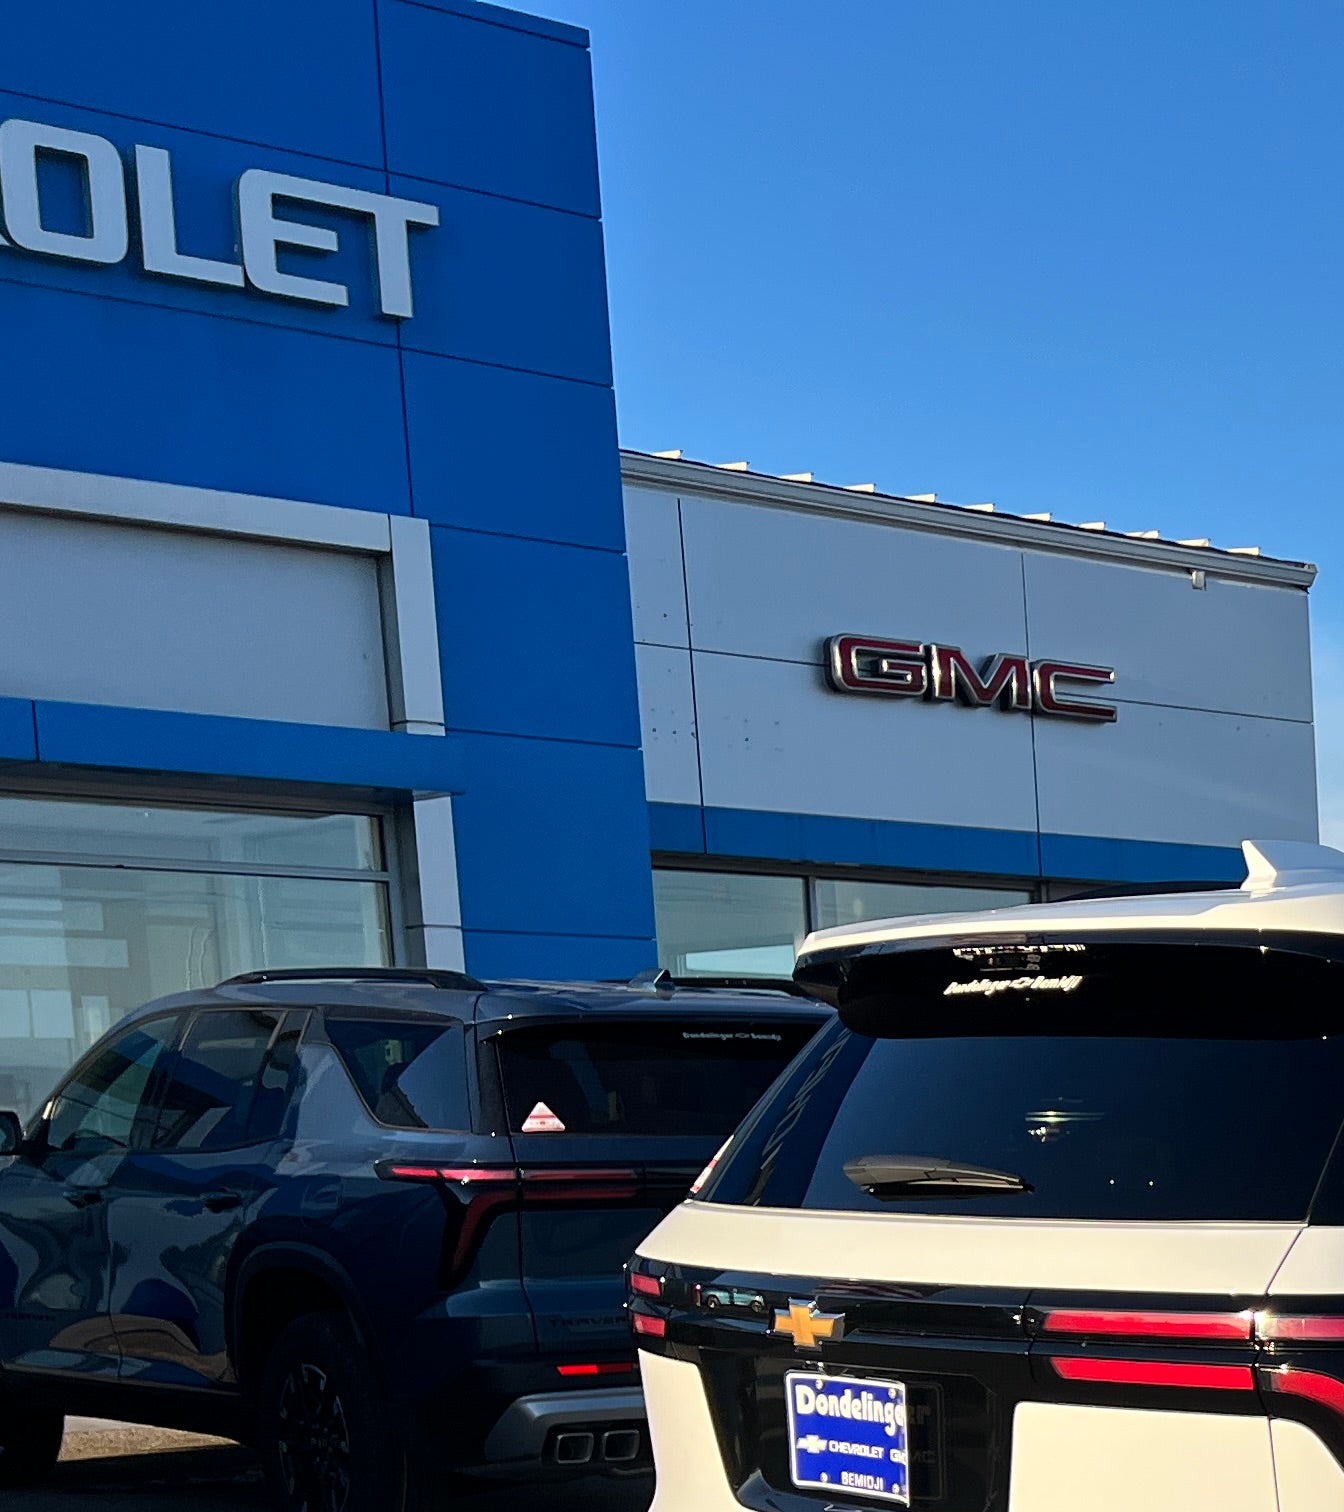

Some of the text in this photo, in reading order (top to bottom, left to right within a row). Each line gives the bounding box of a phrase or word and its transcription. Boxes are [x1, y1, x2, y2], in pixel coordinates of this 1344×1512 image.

[0, 118, 440, 319] OLET
[825, 633, 1118, 723] GMC
[795, 1384, 931, 1437] Dondelinger
[828, 1439, 886, 1460] CHEVROLET
[840, 1470, 884, 1492] BEMIDJI
